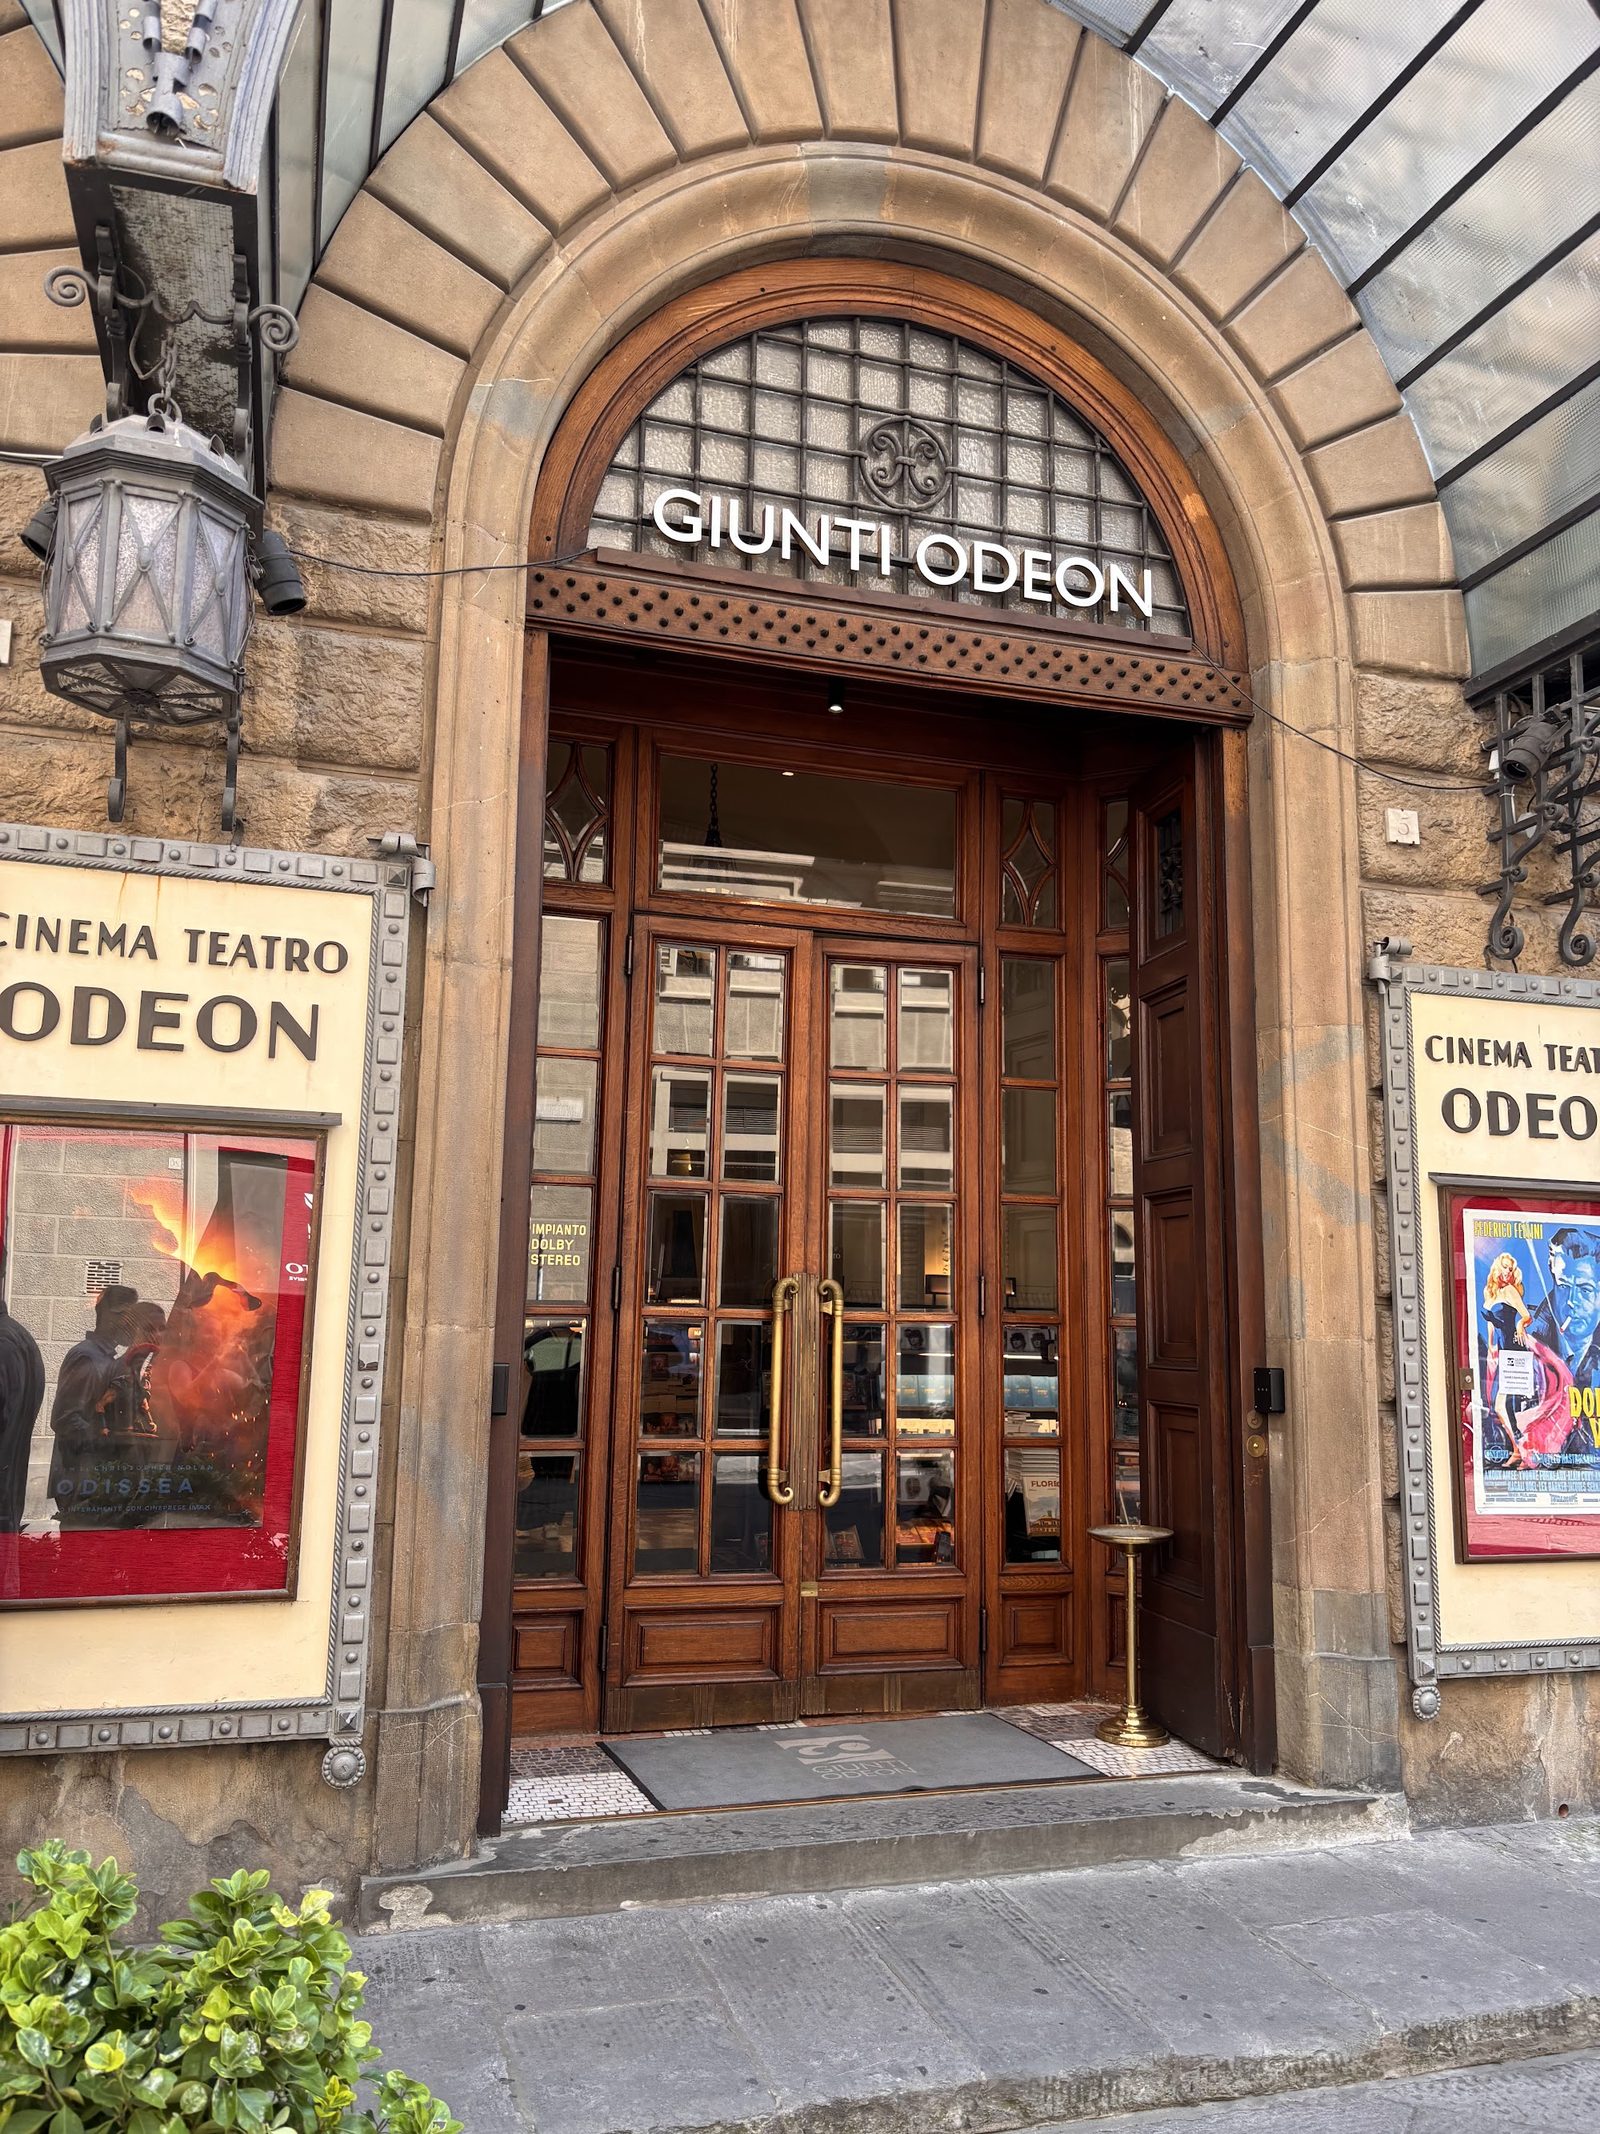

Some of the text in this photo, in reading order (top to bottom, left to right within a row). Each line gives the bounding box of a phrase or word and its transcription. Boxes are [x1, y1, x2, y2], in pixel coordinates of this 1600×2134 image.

[653, 488, 1153, 618] GIUNTI ODEON
[184, 928, 349, 974] TEATRO
[0, 981, 320, 1062] ODEON
[1425, 1034, 1533, 1069] CINEMA
[1441, 1087, 1598, 1141] ODEO
[532, 1223, 587, 1236] IMPIANTO
[1474, 1220, 1544, 1240] FEDERICO FELLINI
[531, 1239, 575, 1250] DOLBY
[530, 1253, 581, 1266] STEREO
[56, 1477, 194, 1496] ODISSEA
[821, 1767, 918, 1780] ODEON
